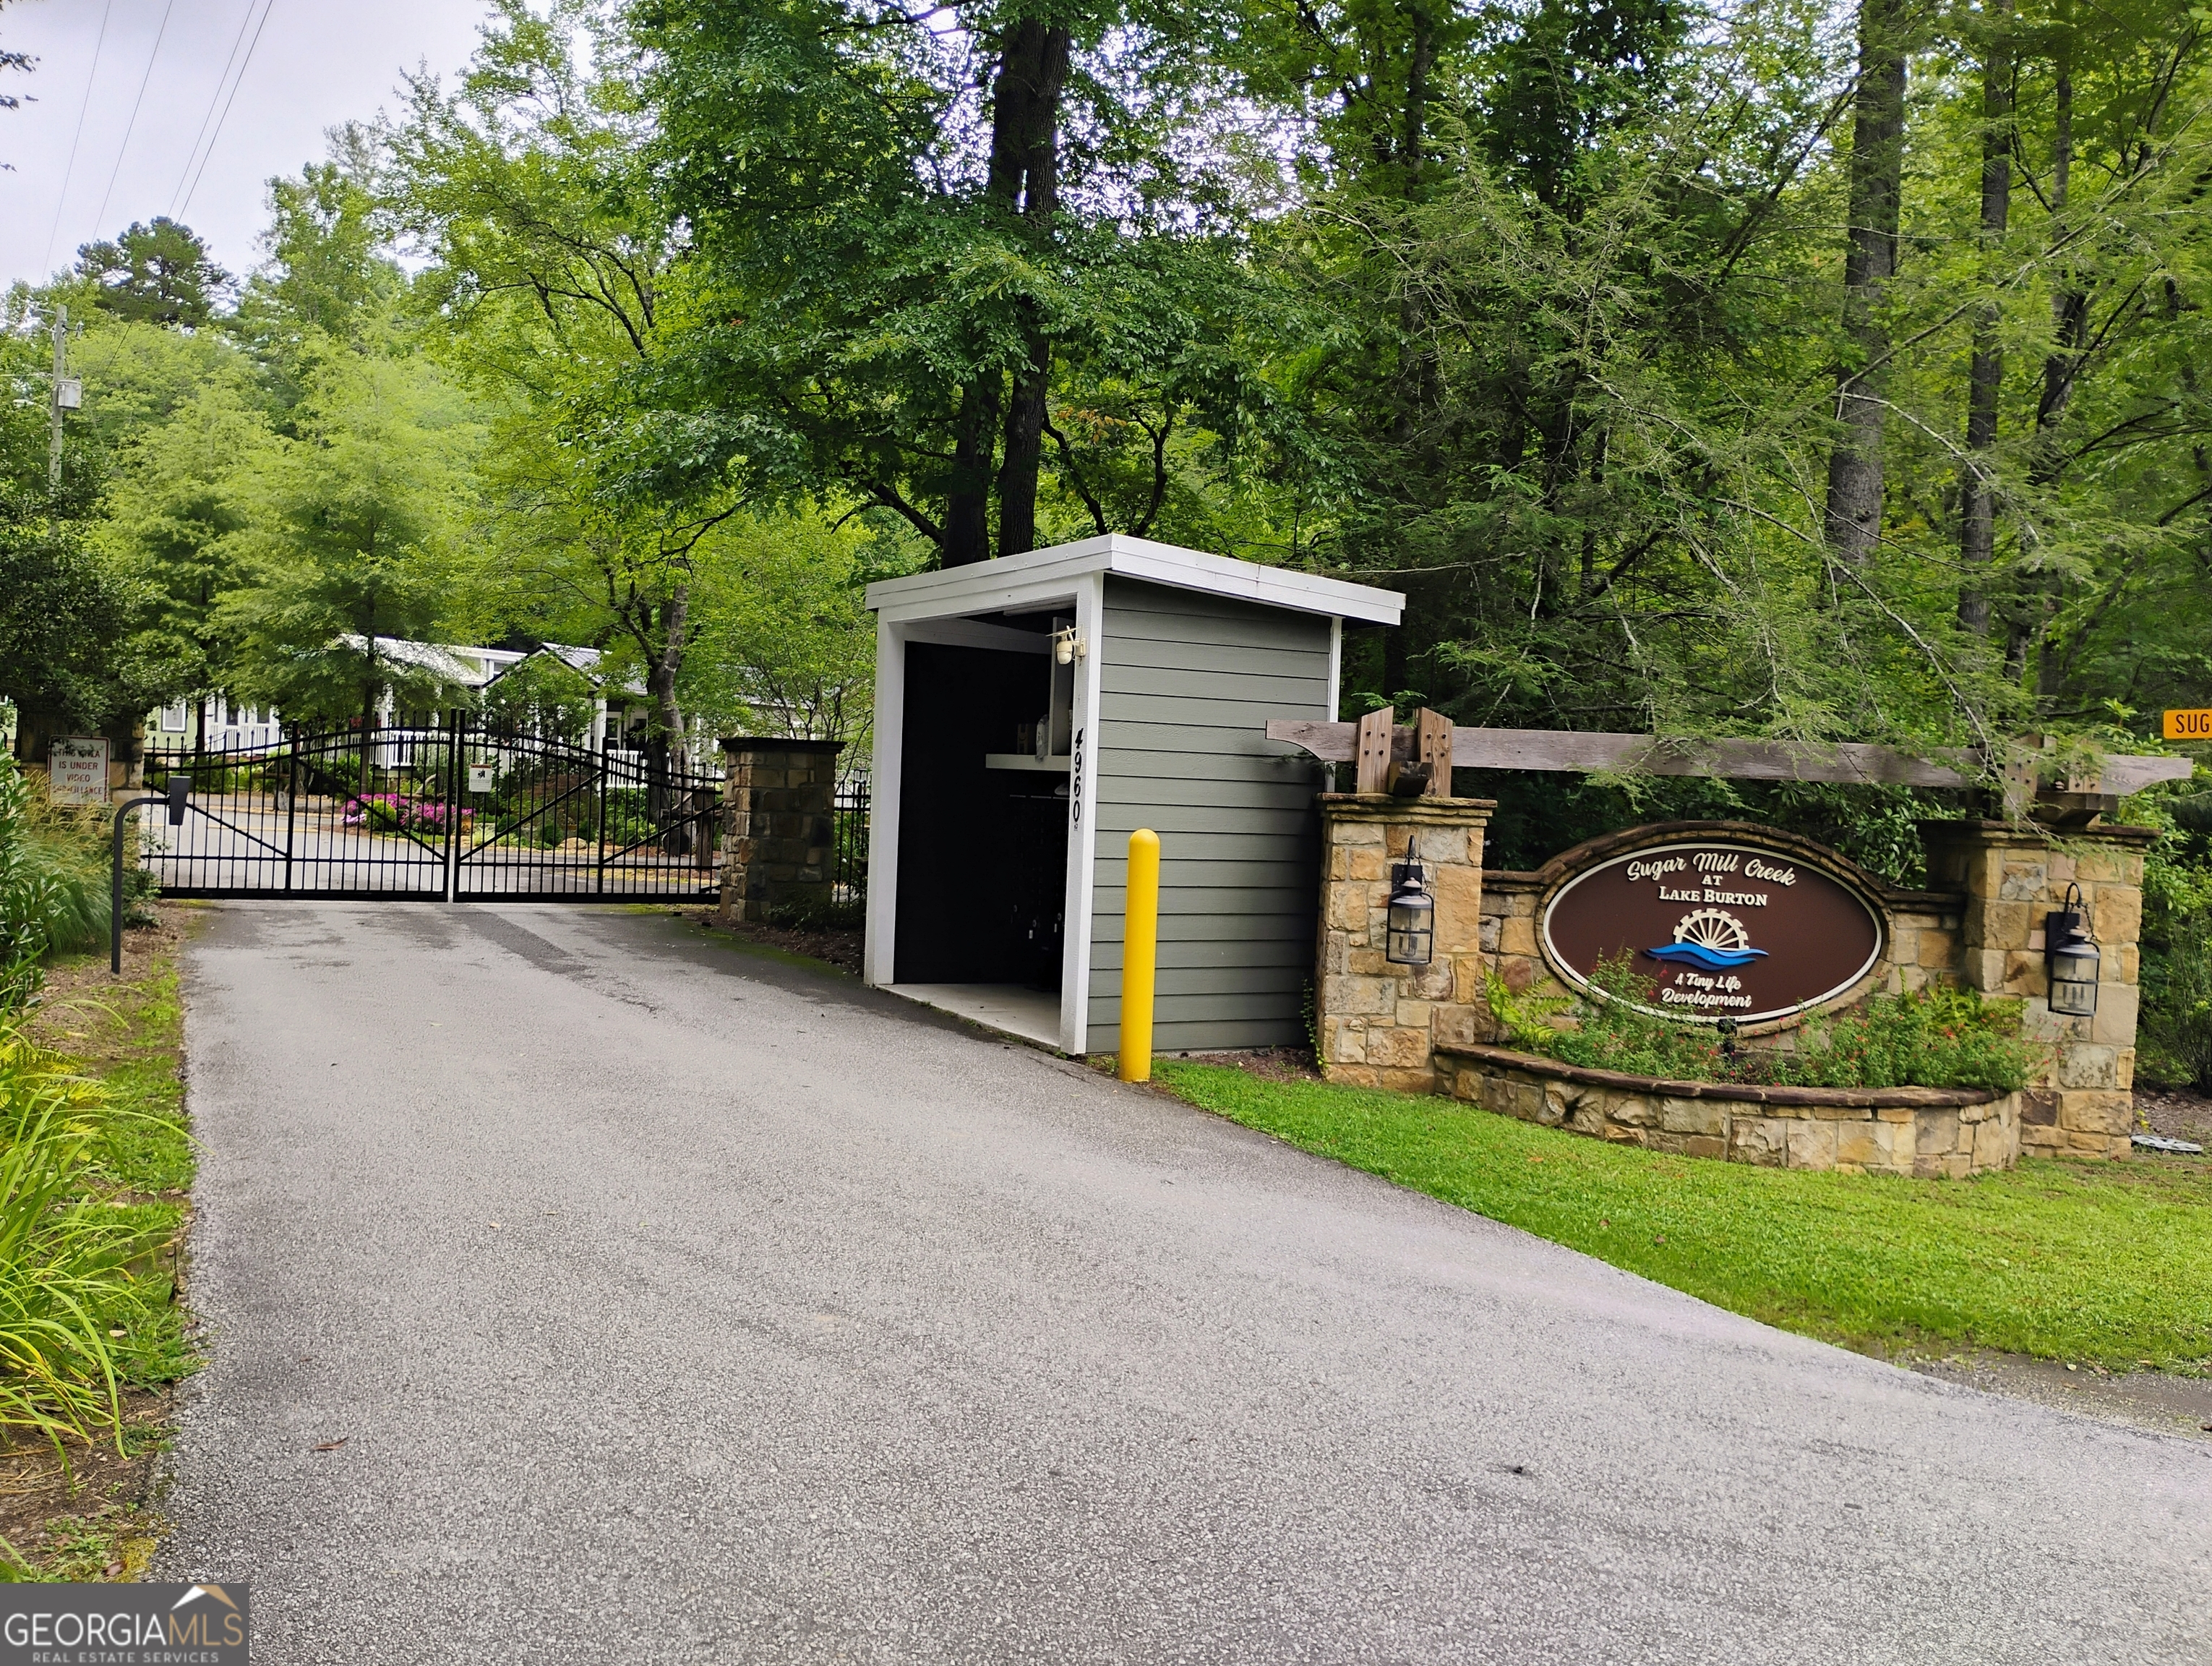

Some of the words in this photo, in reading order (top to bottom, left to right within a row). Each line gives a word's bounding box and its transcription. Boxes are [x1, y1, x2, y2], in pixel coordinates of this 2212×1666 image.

[2175, 713, 2210, 733] SUG
[59, 761, 67, 769] IS
[70, 761, 98, 770] UNDER
[1073, 728, 1084, 822] 4960
[67, 774, 90, 782] VIDEO
[1626, 856, 1687, 881] Sugar
[1692, 853, 1739, 873] Mill
[1744, 858, 1797, 887] Creek
[1701, 874, 1723, 886] AT
[1659, 886, 1701, 902] LAKE
[1703, 889, 1768, 906] BURTON
[1674, 973, 1684, 986] A
[1686, 973, 1715, 991] Tiny
[1715, 975, 1742, 993] Life
[1661, 988, 1752, 1009] Development
